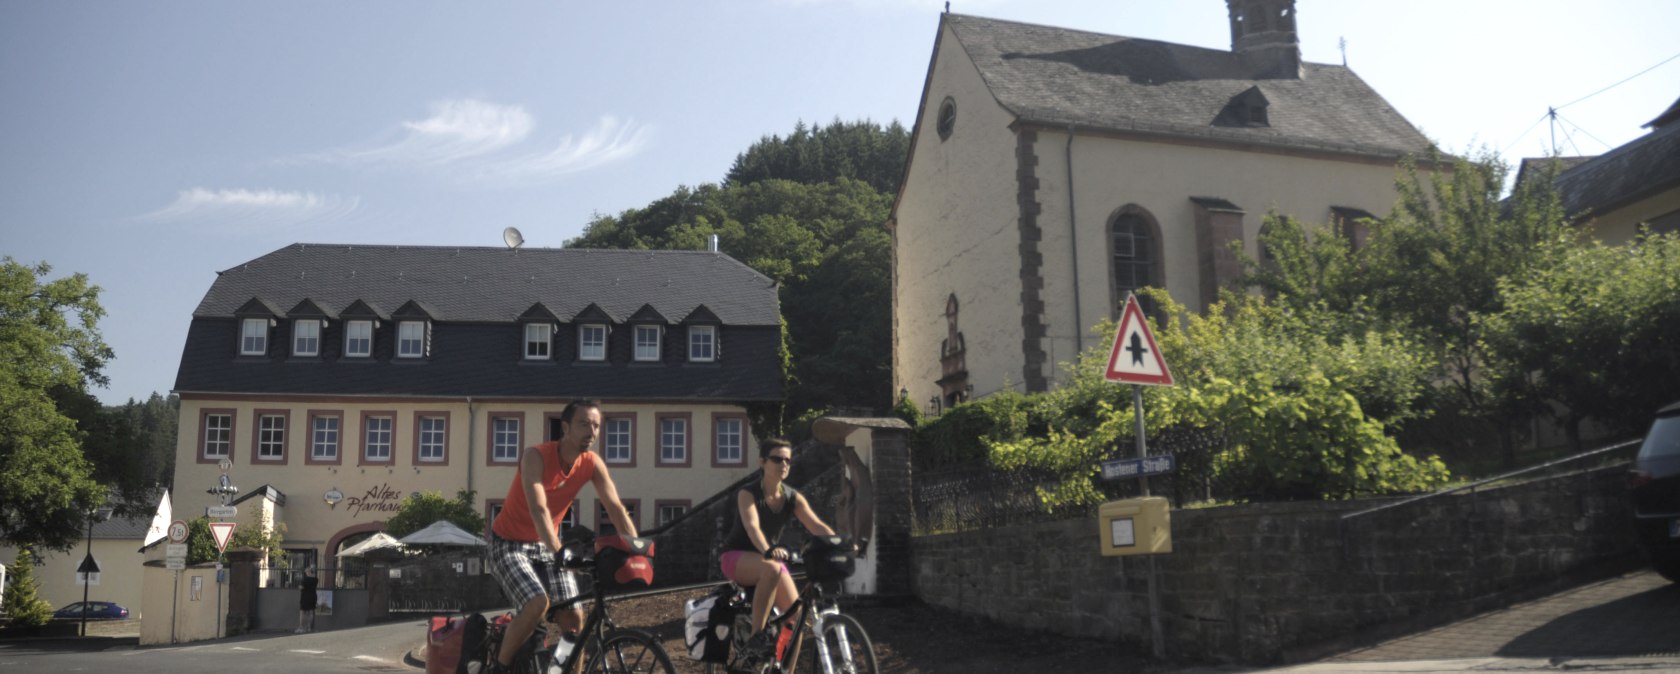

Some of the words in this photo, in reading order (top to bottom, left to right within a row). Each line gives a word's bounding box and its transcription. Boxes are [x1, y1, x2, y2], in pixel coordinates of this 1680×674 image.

[1104, 463, 1138, 479] Hostener
[1143, 458, 1170, 473] Straße
[364, 483, 401, 500] Altes
